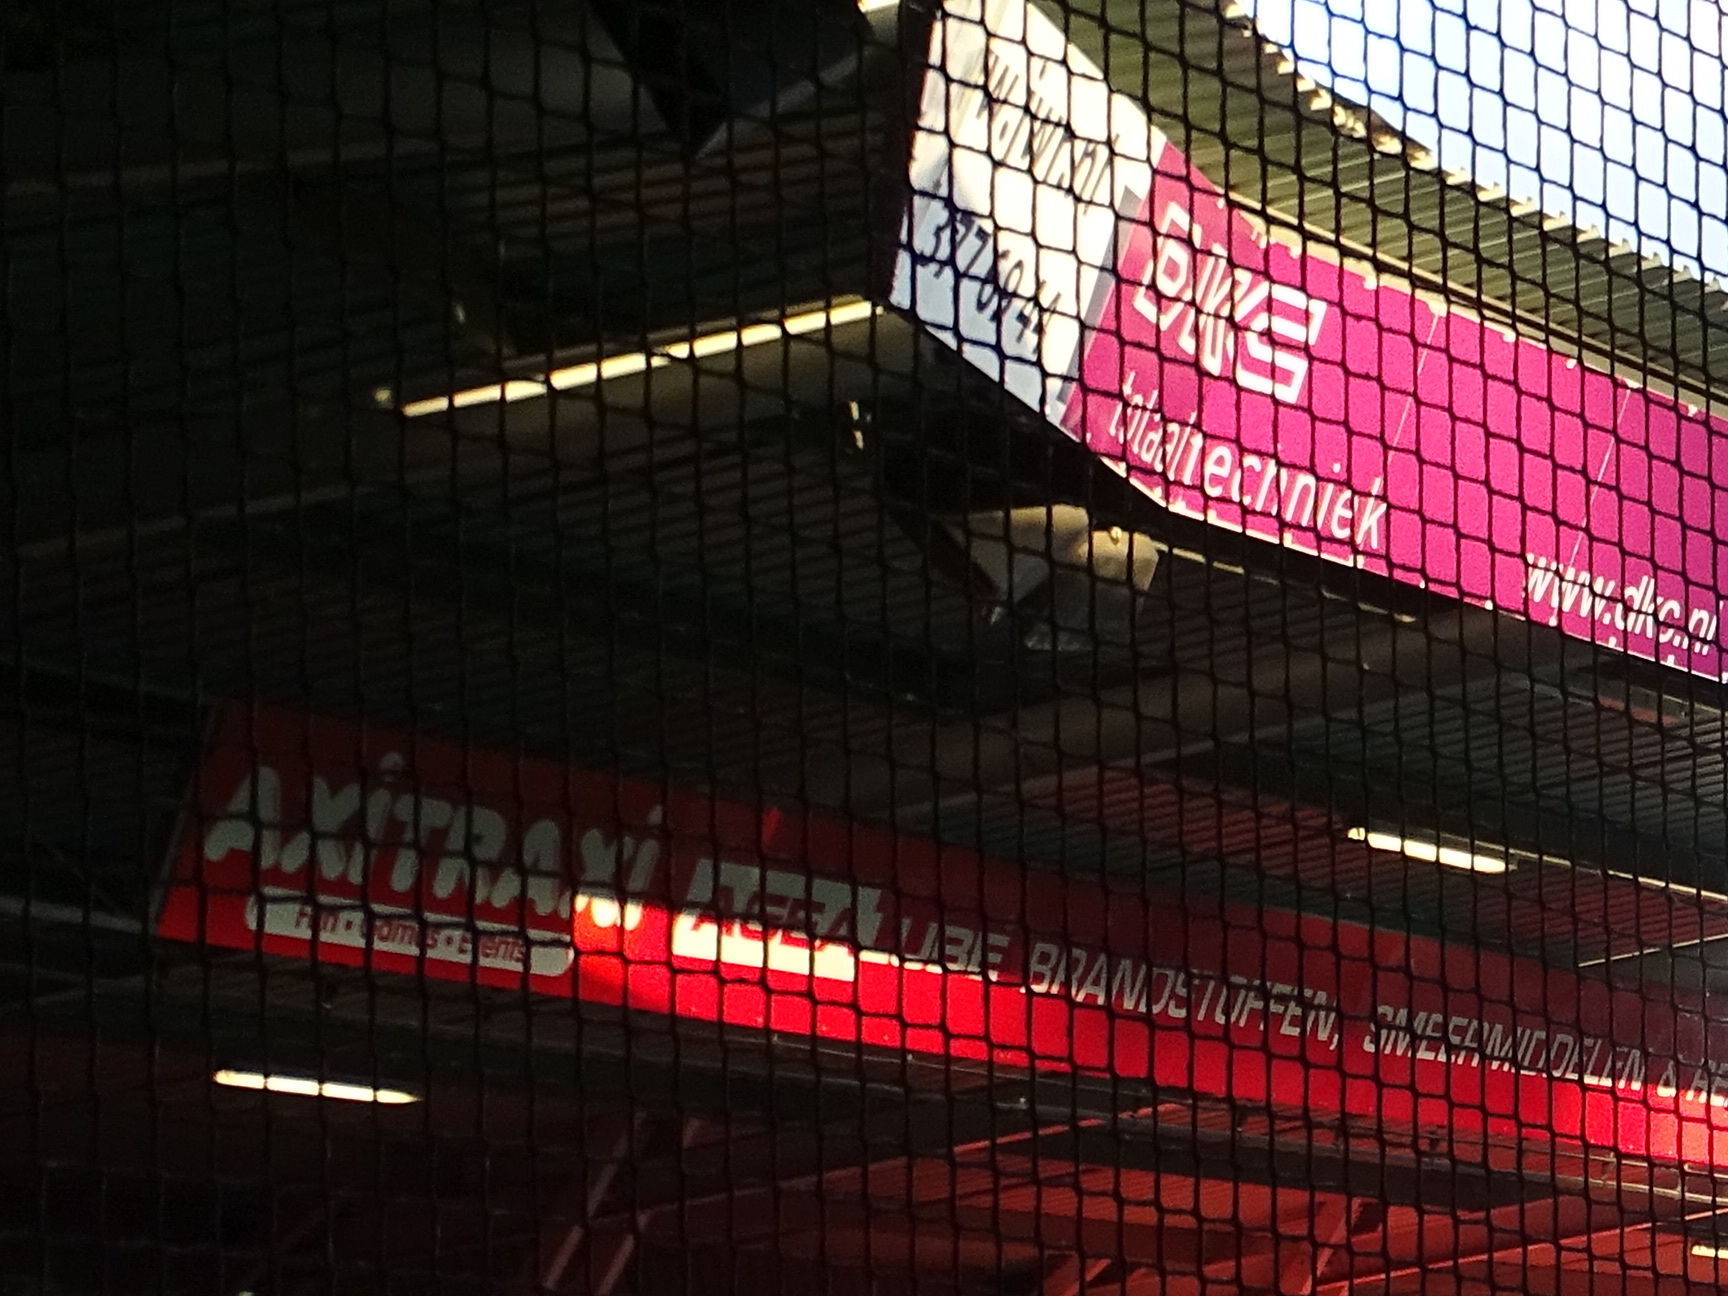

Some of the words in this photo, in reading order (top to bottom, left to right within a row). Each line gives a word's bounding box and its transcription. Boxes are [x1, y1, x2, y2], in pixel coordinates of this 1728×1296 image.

[1107, 371, 1387, 552] totaaltechniek
[1526, 553, 1723, 656] www.dkc.nl
[1024, 938, 1340, 1051] BRANDSTOFFEN,
[1361, 1002, 1645, 1094] SMEERMIDDELEN
[1656, 1063, 1678, 1098] &
